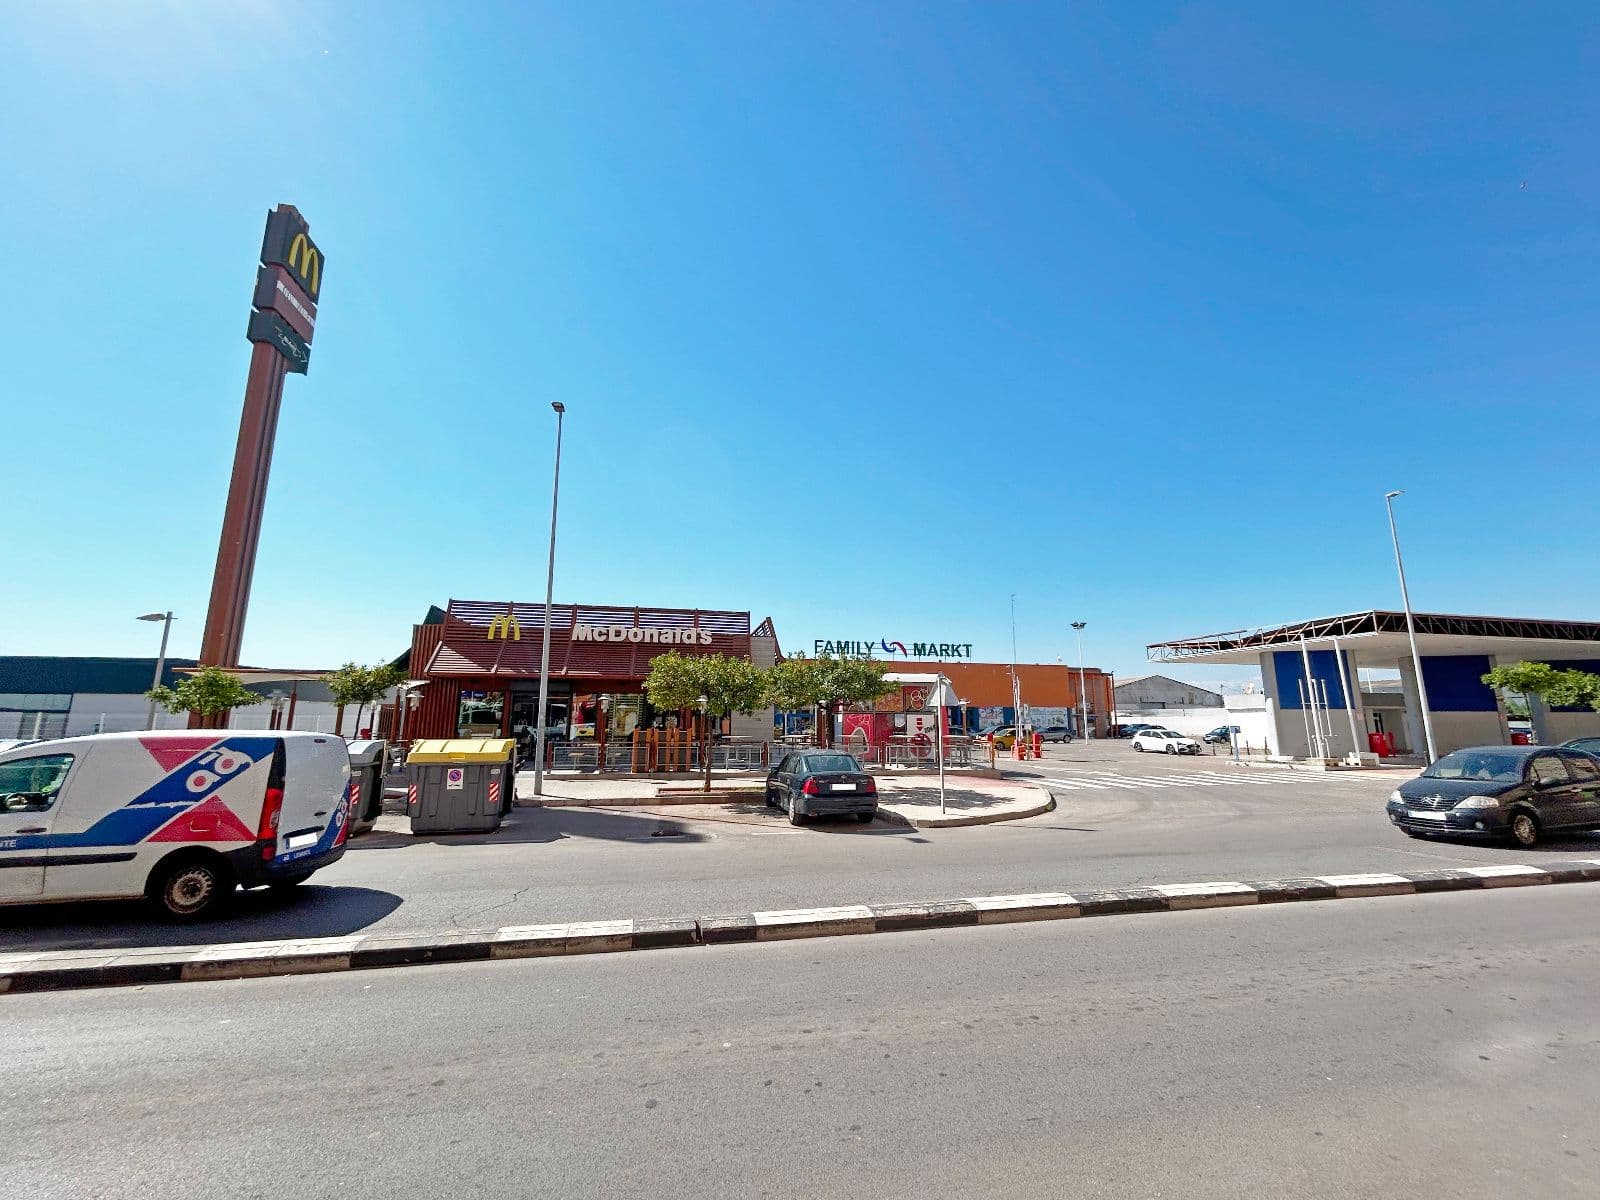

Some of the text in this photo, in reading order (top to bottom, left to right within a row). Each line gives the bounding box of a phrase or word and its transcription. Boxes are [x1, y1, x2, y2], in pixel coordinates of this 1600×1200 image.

[571, 623, 713, 645] McDonald's
[814, 639, 972, 658] FAMILY MARKT
